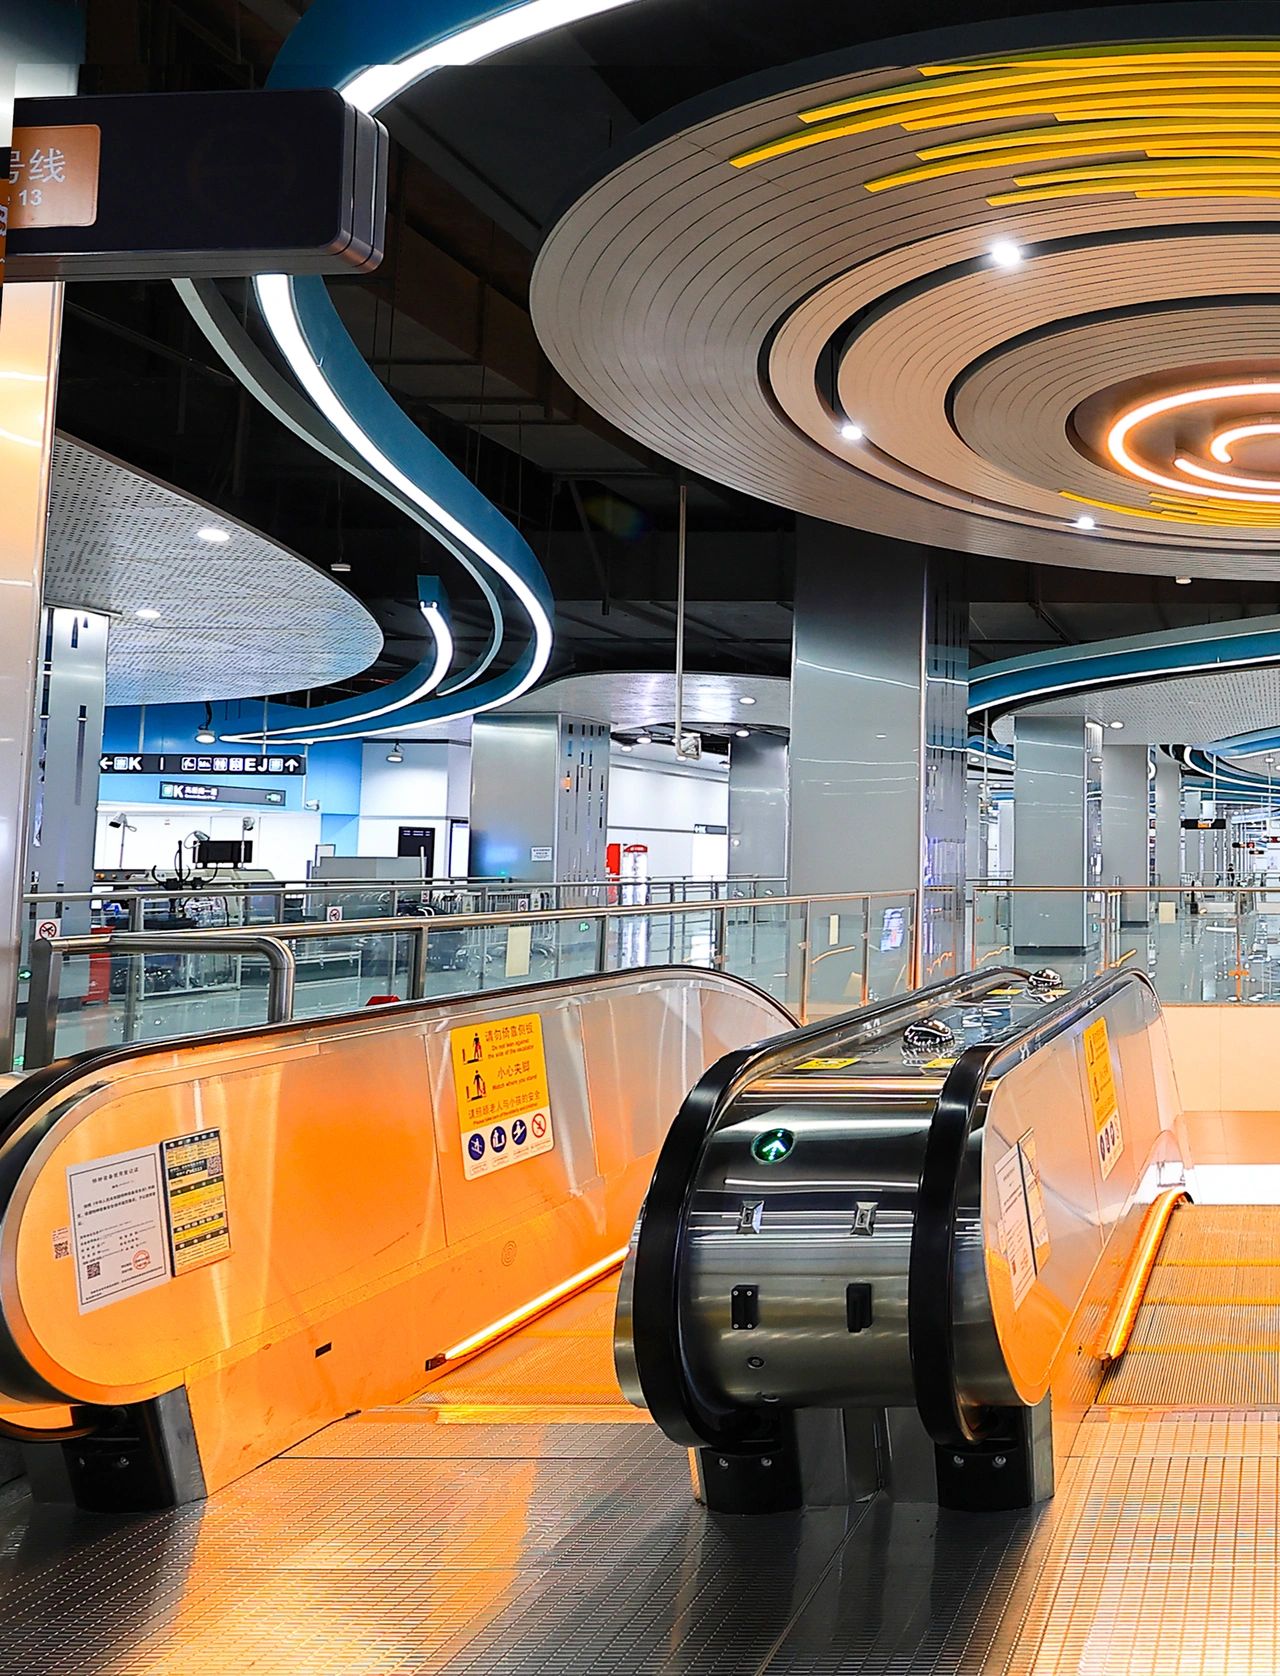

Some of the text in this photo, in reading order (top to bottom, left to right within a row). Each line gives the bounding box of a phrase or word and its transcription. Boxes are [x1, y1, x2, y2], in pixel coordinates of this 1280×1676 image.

[18, 189, 42, 206] 13
[129, 757, 143, 771] K
[244, 757, 268, 772] EJ
[173, 784, 184, 798] K
